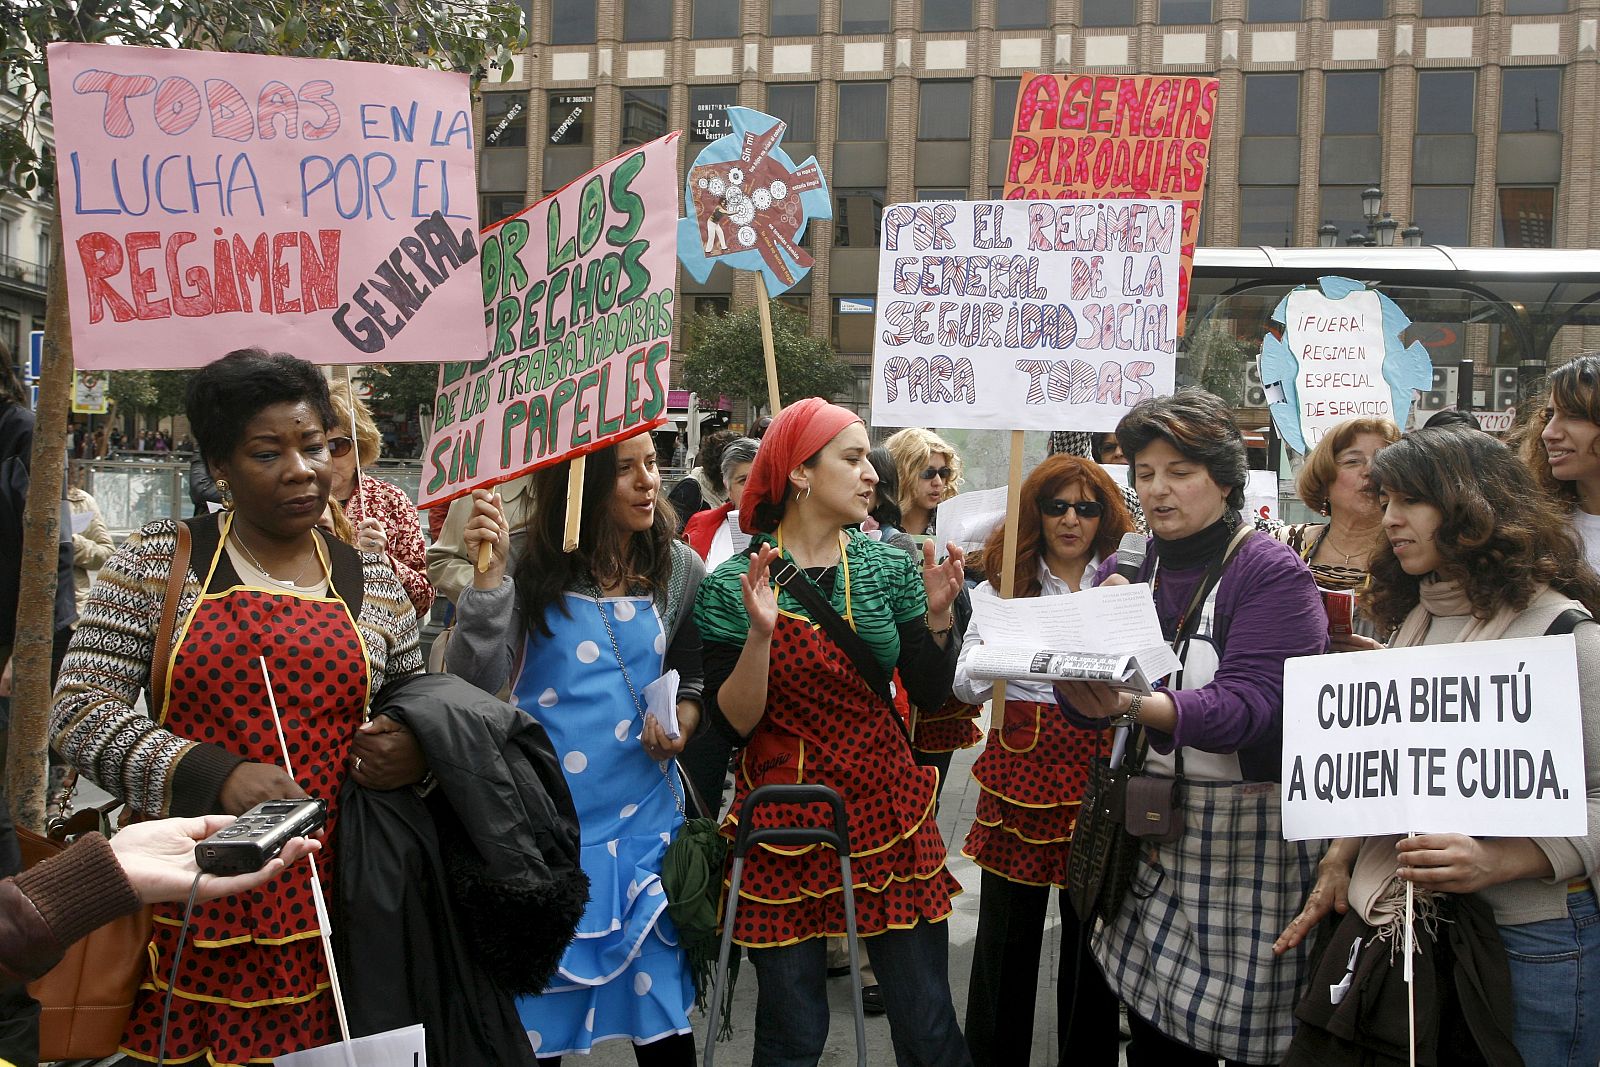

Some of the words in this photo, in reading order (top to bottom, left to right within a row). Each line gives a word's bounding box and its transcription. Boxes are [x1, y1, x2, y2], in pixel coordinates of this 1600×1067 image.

[73, 69, 340, 141] TODAS
[360, 101, 417, 141] EN
[431, 111, 472, 149] LA
[1017, 74, 1219, 140] AGENCIAS
[742, 148, 752, 162] Sin
[1008, 135, 1206, 193] PARROQUIAS
[70, 152, 264, 216] LUCHA
[300, 152, 396, 220] POR
[411, 159, 472, 220] EL
[481, 219, 530, 305] OR
[548, 151, 645, 275] LOS
[886, 204, 956, 251] POR
[974, 204, 1012, 249] EL
[332, 210, 479, 354] GENERAL
[894, 254, 1048, 300] GENERAL
[1070, 256, 1106, 300] DE
[1122, 255, 1164, 298] LA
[882, 300, 1078, 350] SEGURIDAD
[1298, 312, 1364, 332] ¡FUERA!
[434, 388, 460, 434] DE
[460, 369, 495, 422] LAS
[497, 288, 673, 405] TRABAJADORAS
[1302, 344, 1366, 360] REGIMEN
[500, 341, 670, 470] PAPELES
[884, 354, 976, 404] PARA
[1015, 359, 1155, 406] TODAS
[1306, 373, 1374, 388] ESPECIAL
[1305, 402, 1325, 417] DE
[1329, 401, 1388, 416] SERVICIO
[1318, 680, 1402, 730] CUIDA
[1410, 676, 1480, 722] BIEN
[1490, 662, 1532, 723] TÚ
[1288, 756, 1306, 801] A
[1314, 749, 1398, 803] QUIEN
[1408, 748, 1446, 796] TE
[1456, 748, 1568, 800] CUIDA.
